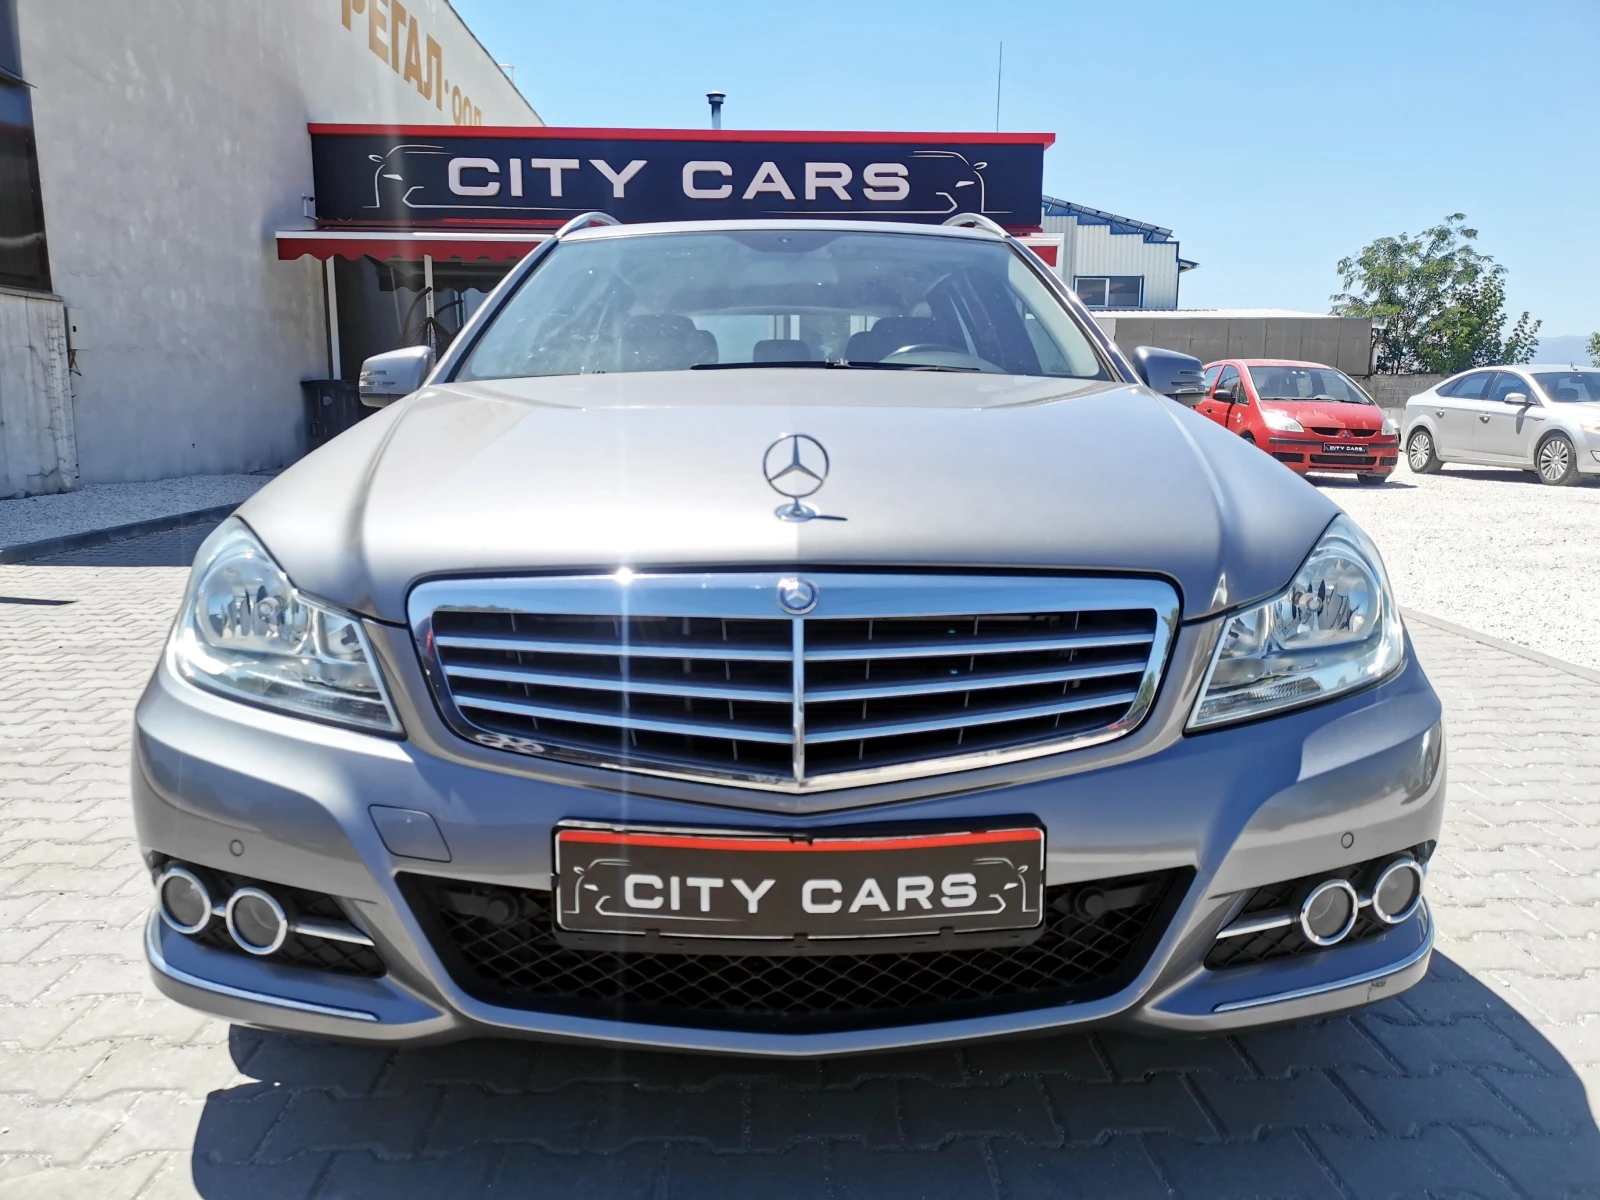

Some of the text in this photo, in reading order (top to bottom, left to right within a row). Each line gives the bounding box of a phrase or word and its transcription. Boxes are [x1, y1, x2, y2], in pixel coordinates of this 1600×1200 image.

[448, 157, 911, 200] CITY CARS
[624, 873, 978, 914] CITY CARS
